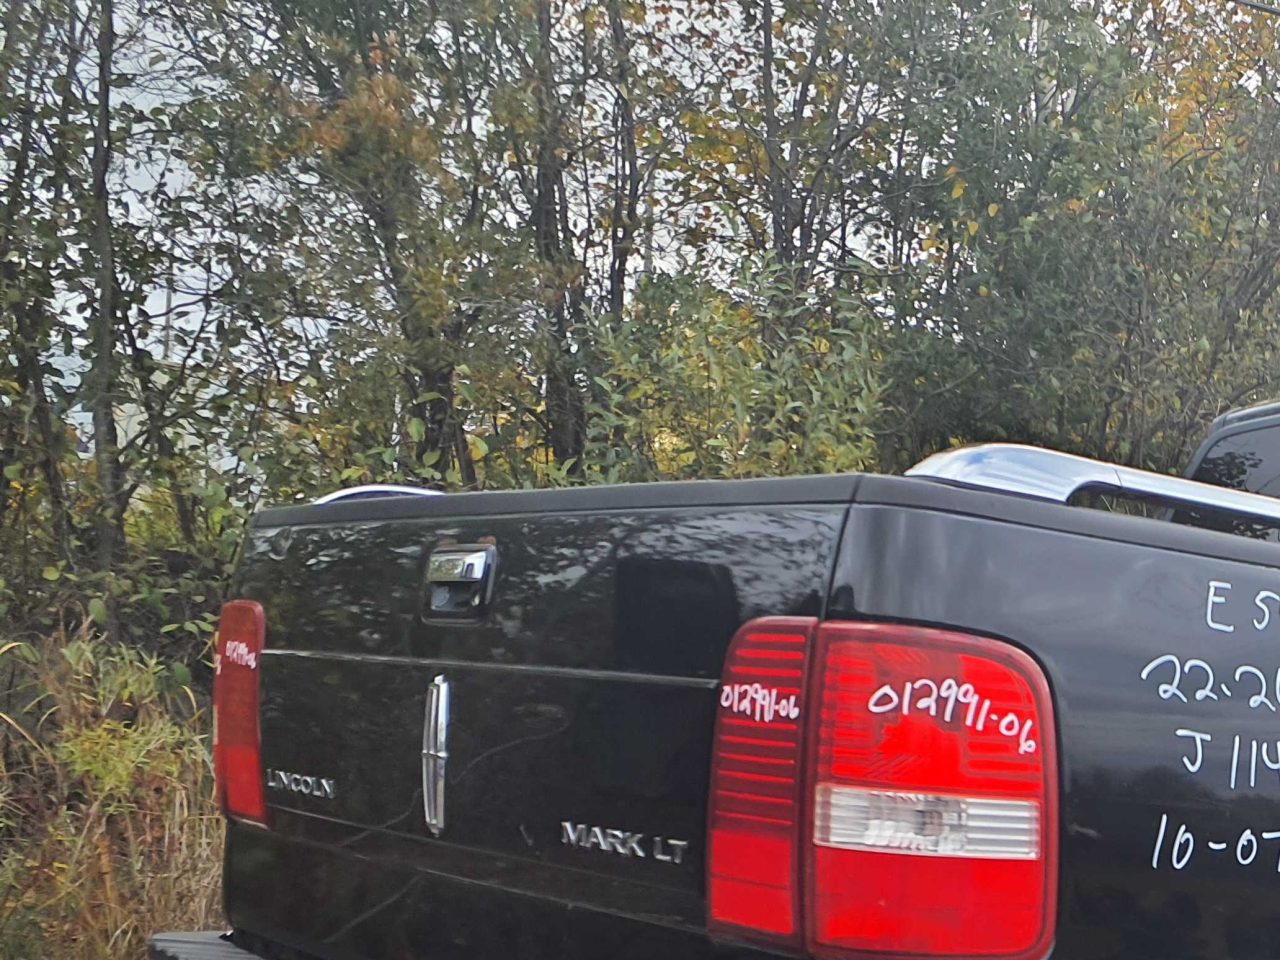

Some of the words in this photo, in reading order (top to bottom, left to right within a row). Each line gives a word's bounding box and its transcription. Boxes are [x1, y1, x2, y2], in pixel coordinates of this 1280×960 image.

[1206, 580, 1234, 632] E
[720, 683, 800, 722] 012991-06
[868, 678, 1037, 754] 012991-06
[1175, 729, 1211, 773] J
[266, 768, 337, 799] LINCOLN
[561, 821, 645, 857] MARK
[653, 836, 688, 864] LT
